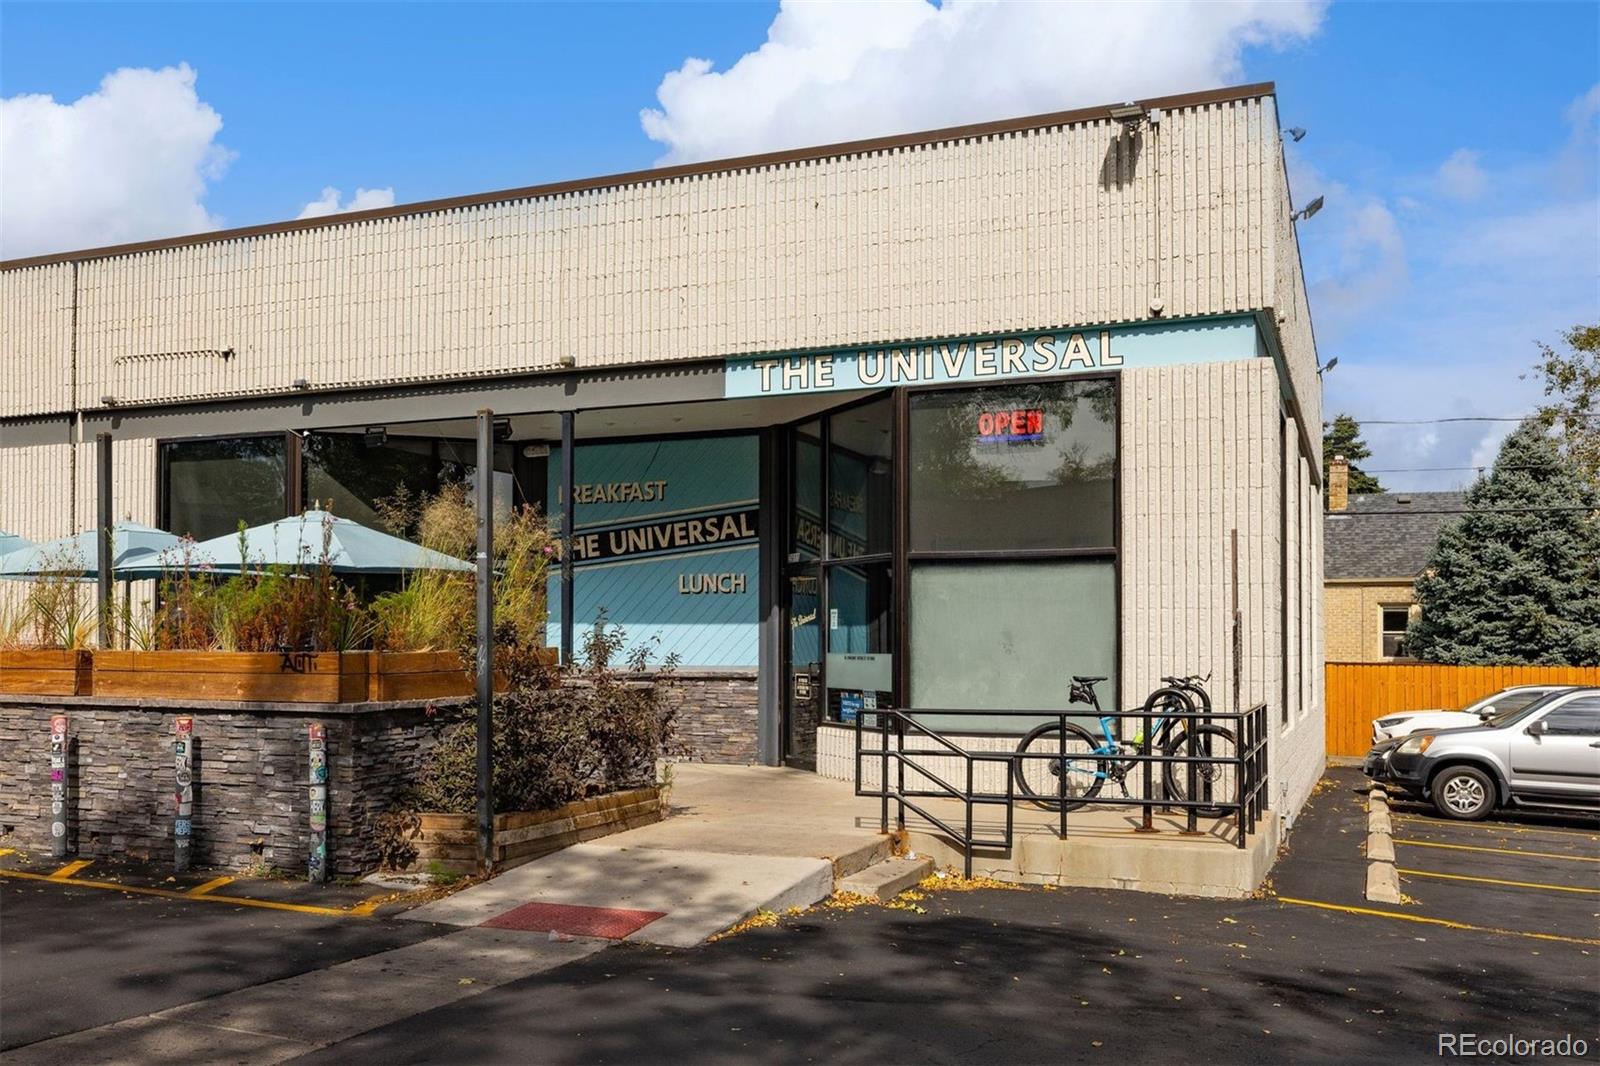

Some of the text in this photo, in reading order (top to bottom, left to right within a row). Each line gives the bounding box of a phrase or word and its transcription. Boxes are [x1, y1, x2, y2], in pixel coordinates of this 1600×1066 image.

[754, 331, 1124, 392] THE UNIVERSAL
[978, 410, 1043, 436] OPEN
[558, 480, 668, 505] REAKFAST
[557, 533, 600, 560] HE
[609, 512, 755, 555] UNIVERSAL
[678, 572, 746, 595] LUNCH
